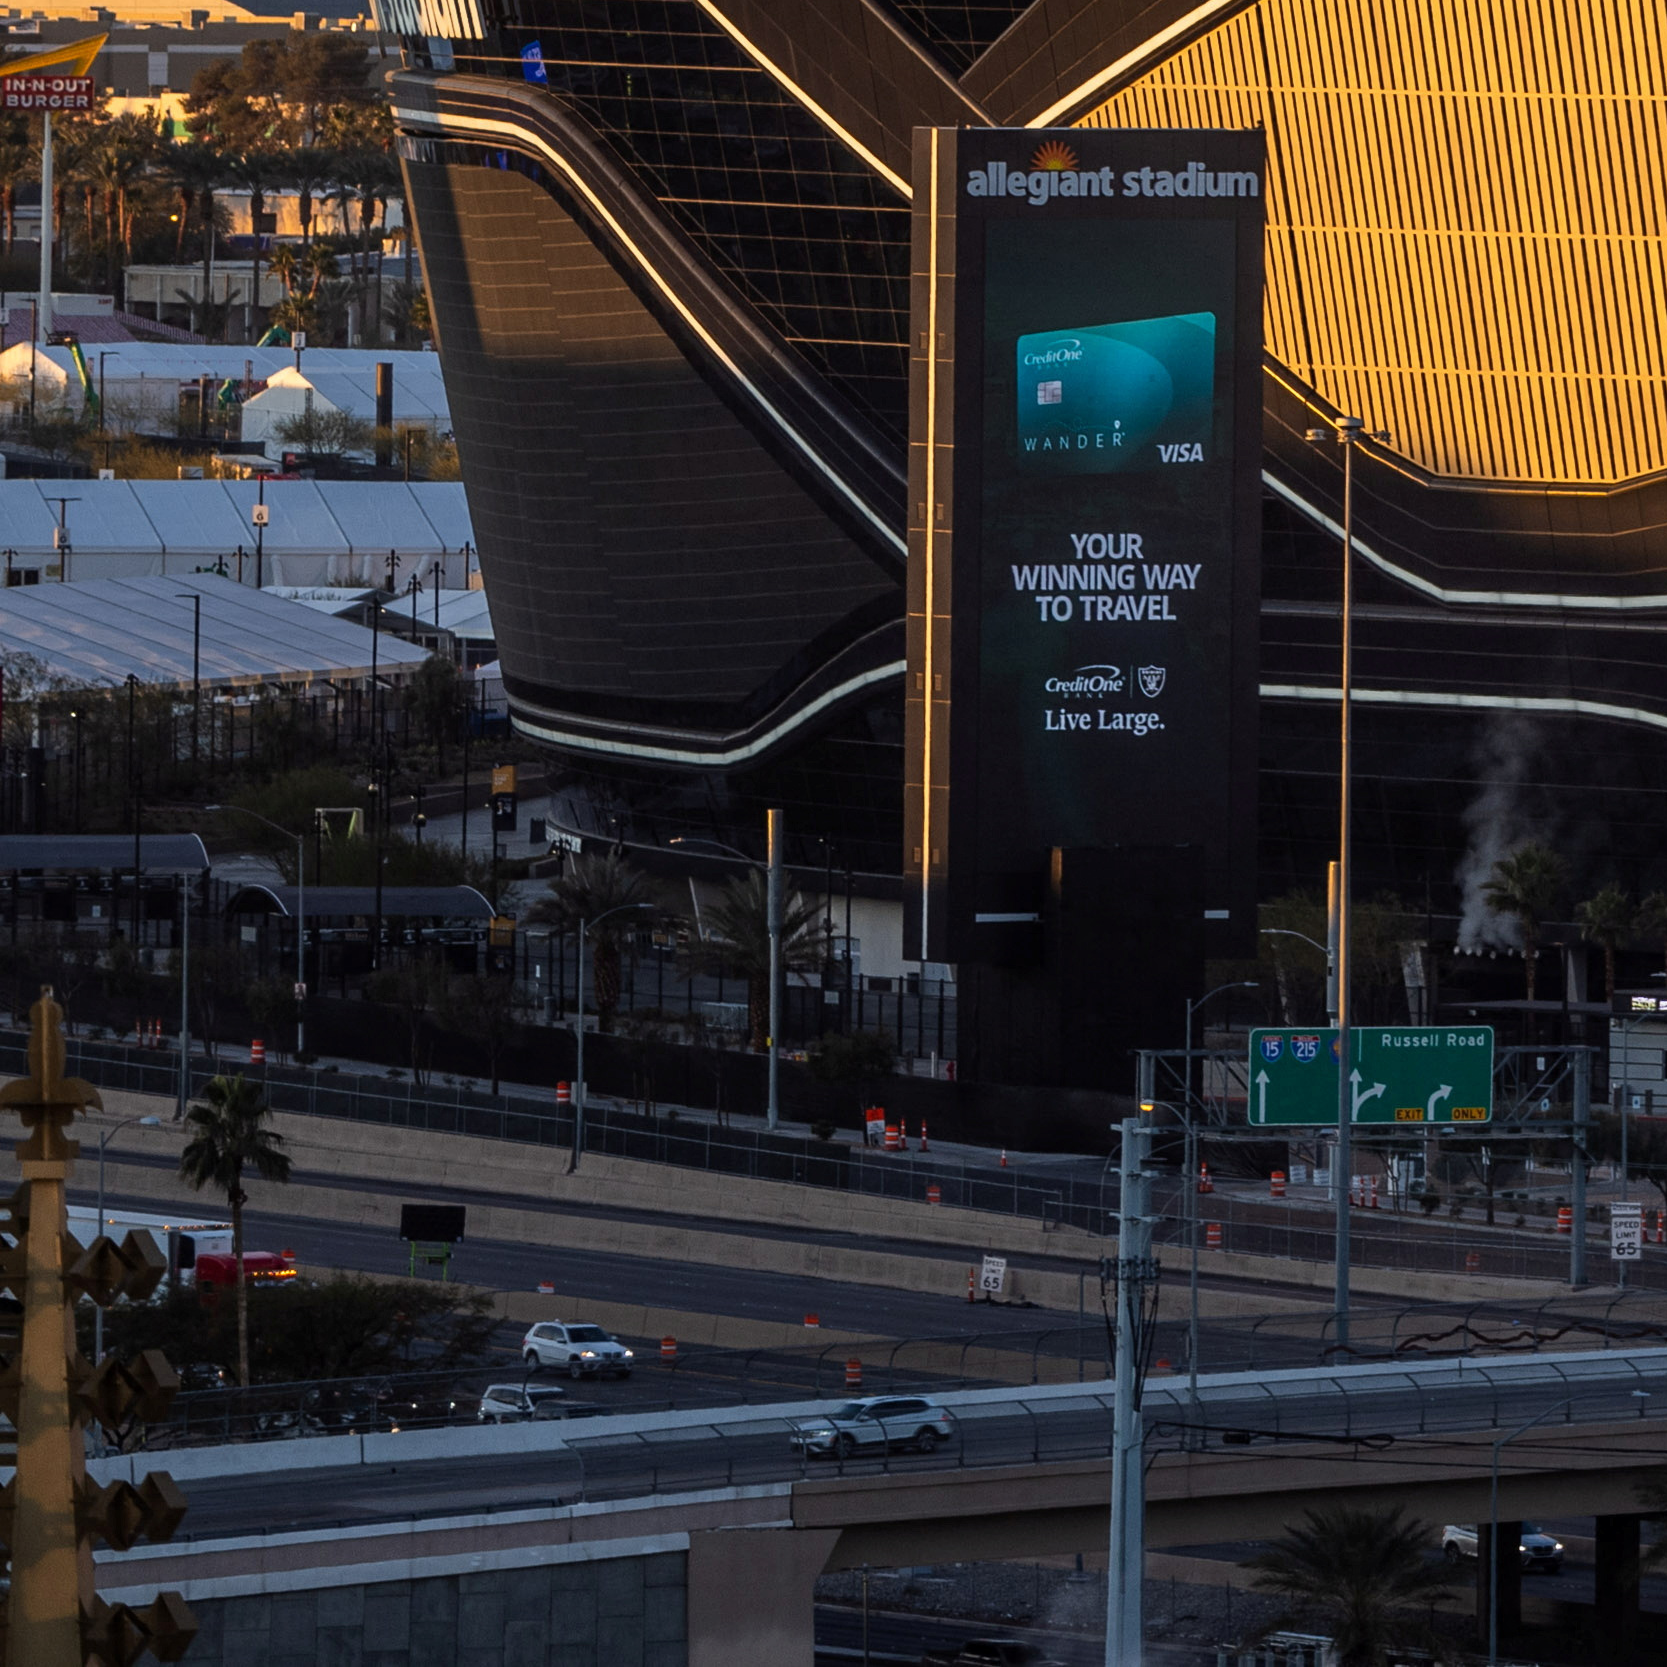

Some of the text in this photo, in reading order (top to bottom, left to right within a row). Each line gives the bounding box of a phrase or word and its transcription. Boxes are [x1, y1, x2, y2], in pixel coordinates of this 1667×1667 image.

[5, 78, 90, 93] IN-N-OUT
[5, 94, 90, 108] BURGER
[966, 162, 1259, 206] allegiant stadium
[1024, 432, 1123, 452] WANDER
[1156, 442, 1205, 464] VISA
[1070, 533, 1144, 560] YOUR
[1011, 563, 1202, 591] WINNING WAY
[1035, 595, 1177, 622] TO TRAVEL
[1044, 709, 1166, 737] Live Large.
[1382, 1033, 1485, 1047] Russell Road
[1266, 1041, 1280, 1058] 15
[1296, 1041, 1317, 1058] 215
[1395, 1108, 1422, 1121] EXIT
[1452, 1108, 1485, 1120] ONLY
[1613, 1220, 1640, 1229] SPEED
[1615, 1231, 1637, 1239] LIMIT
[1615, 1241, 1637, 1256] 65
[983, 1276, 1000, 1289] 65
